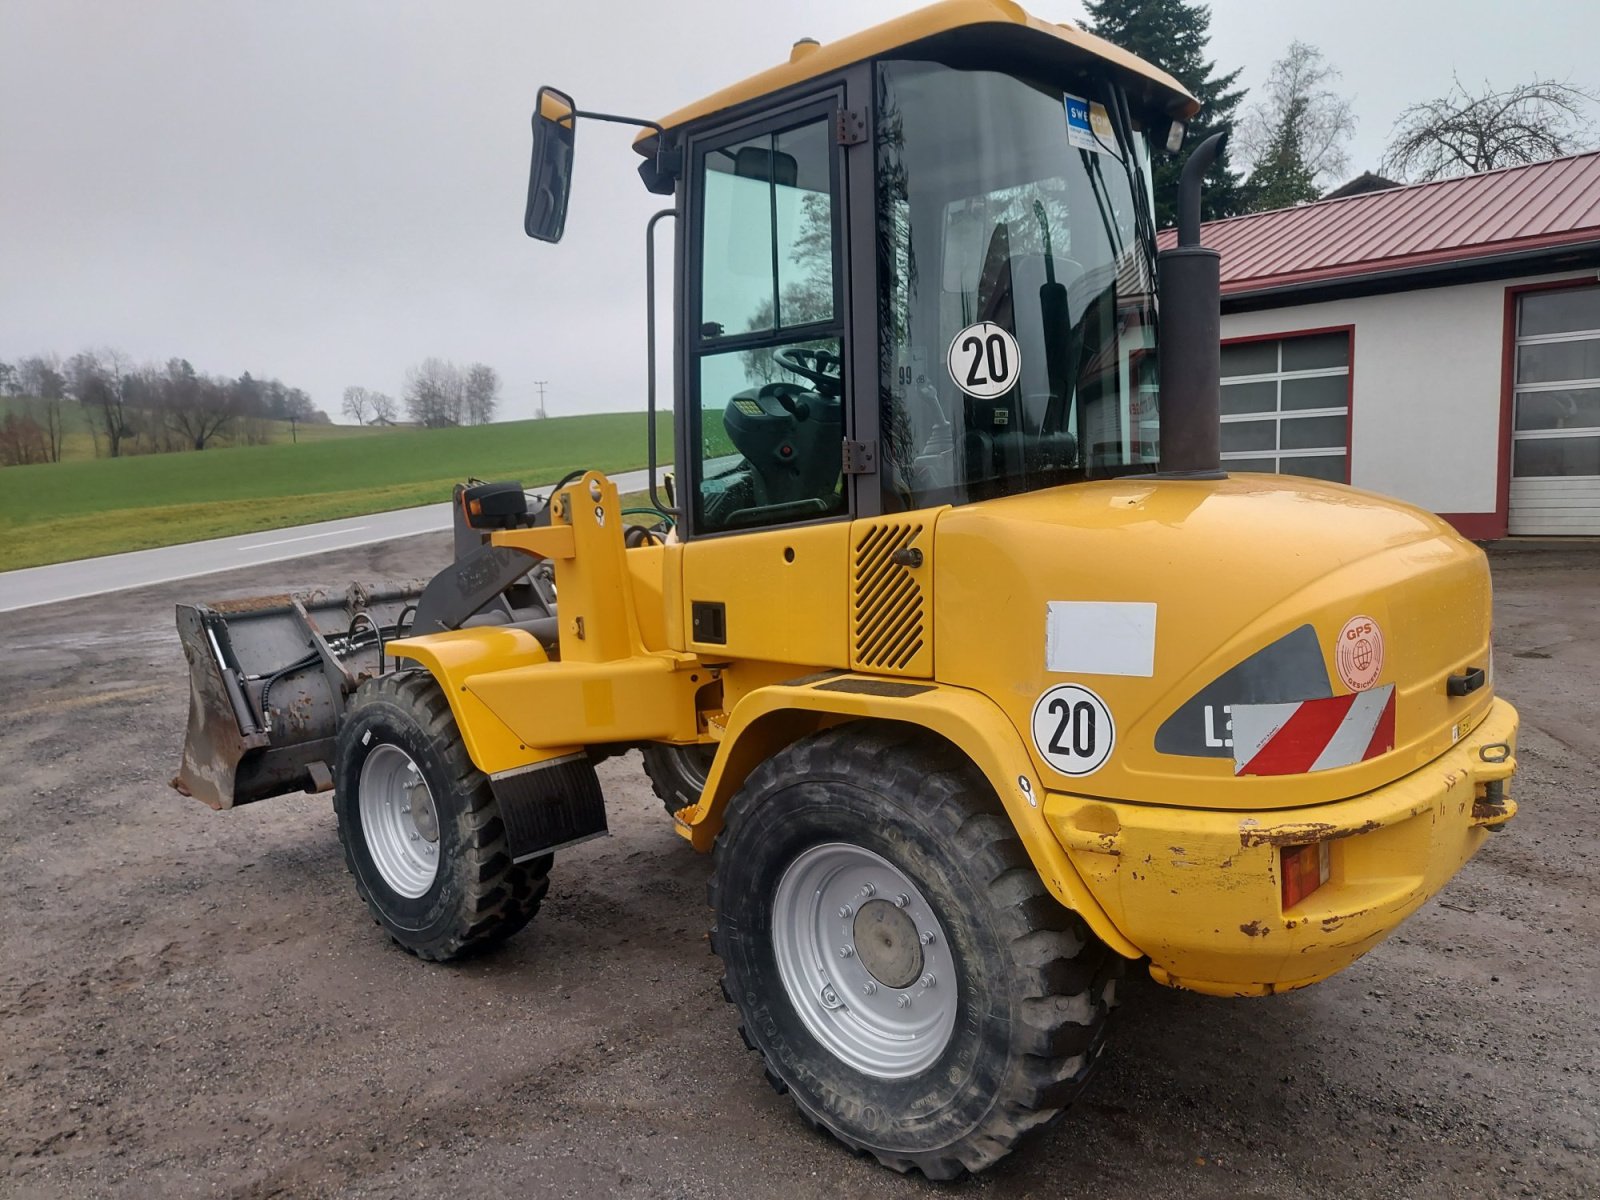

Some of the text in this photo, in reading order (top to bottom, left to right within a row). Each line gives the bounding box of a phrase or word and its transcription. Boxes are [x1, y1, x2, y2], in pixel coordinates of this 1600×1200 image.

[962, 333, 1008, 386] 20
[899, 366, 911, 385] 99
[1346, 623, 1372, 641] GPS
[1347, 667, 1379, 689] GESICHERT
[1048, 698, 1096, 758] 20
